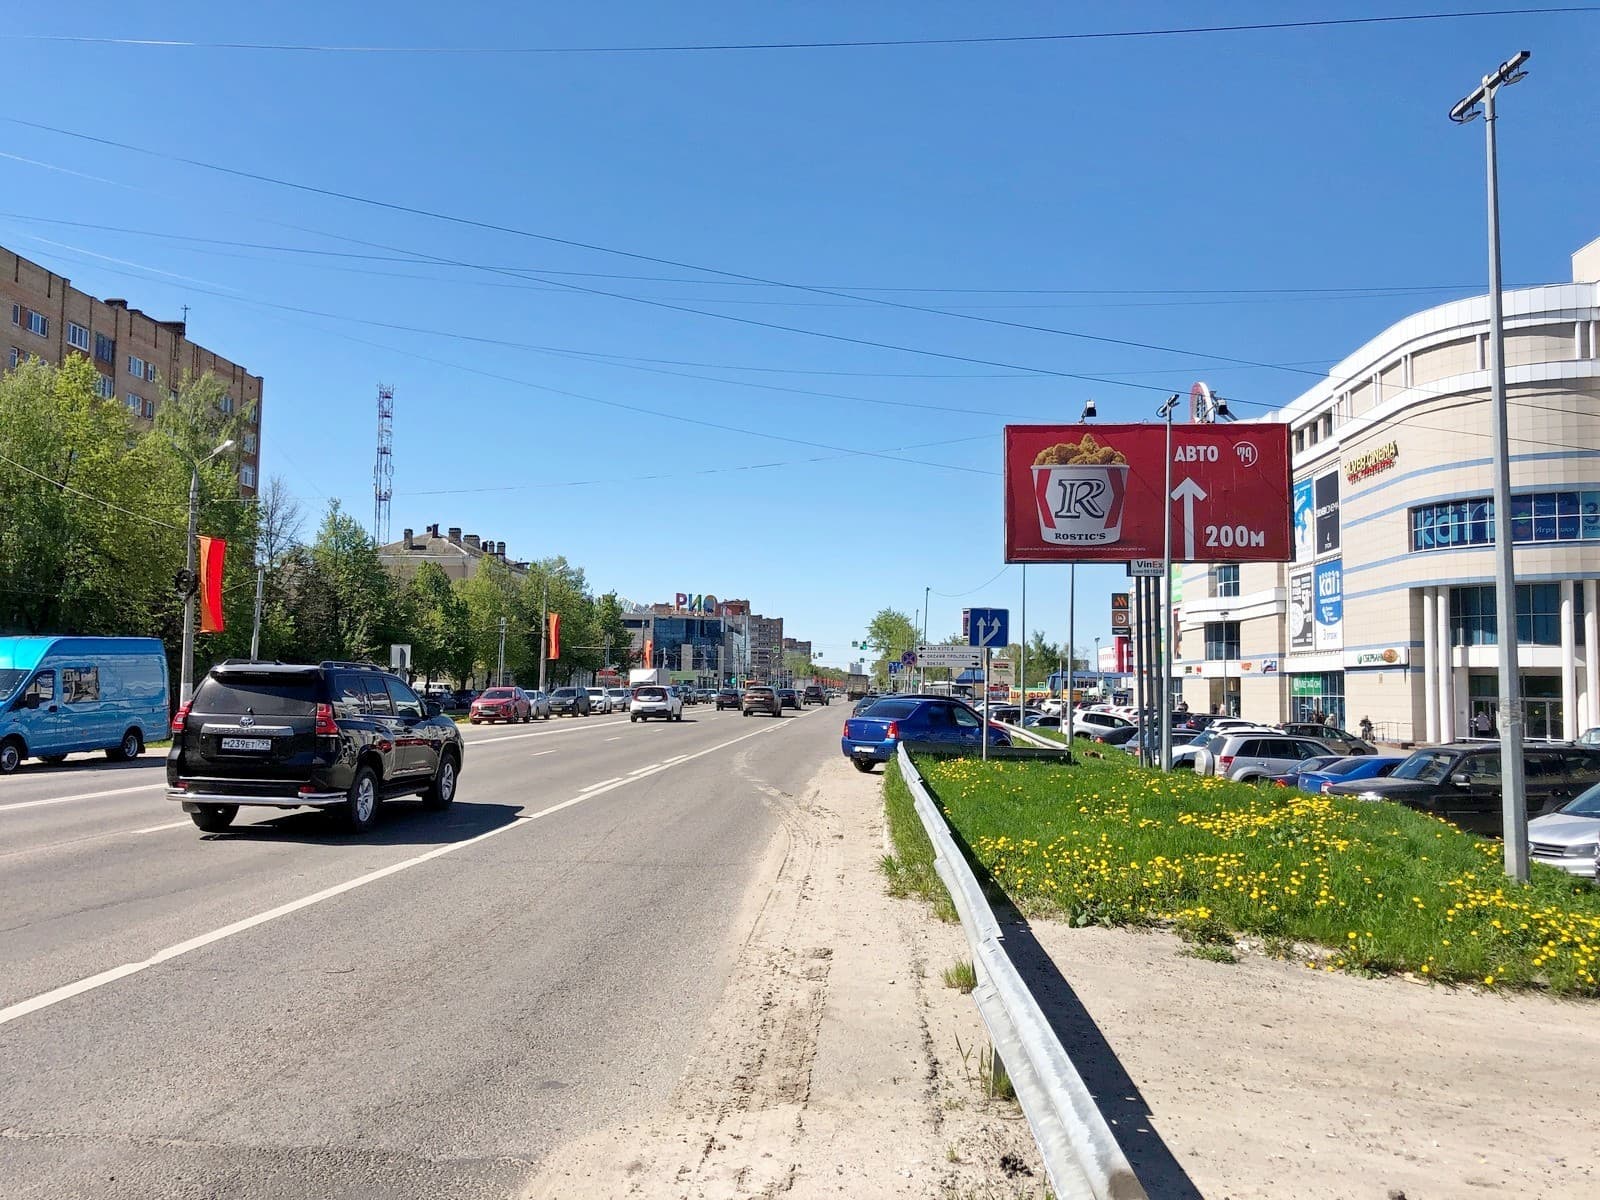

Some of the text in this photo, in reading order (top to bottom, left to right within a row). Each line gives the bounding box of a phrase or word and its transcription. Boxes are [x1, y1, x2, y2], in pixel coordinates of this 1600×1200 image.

[1174, 445, 1219, 462] АВТО
[1054, 478, 1106, 519] R
[1054, 532, 1107, 541] ROSTIC'S
[675, 592, 717, 613] РИО
